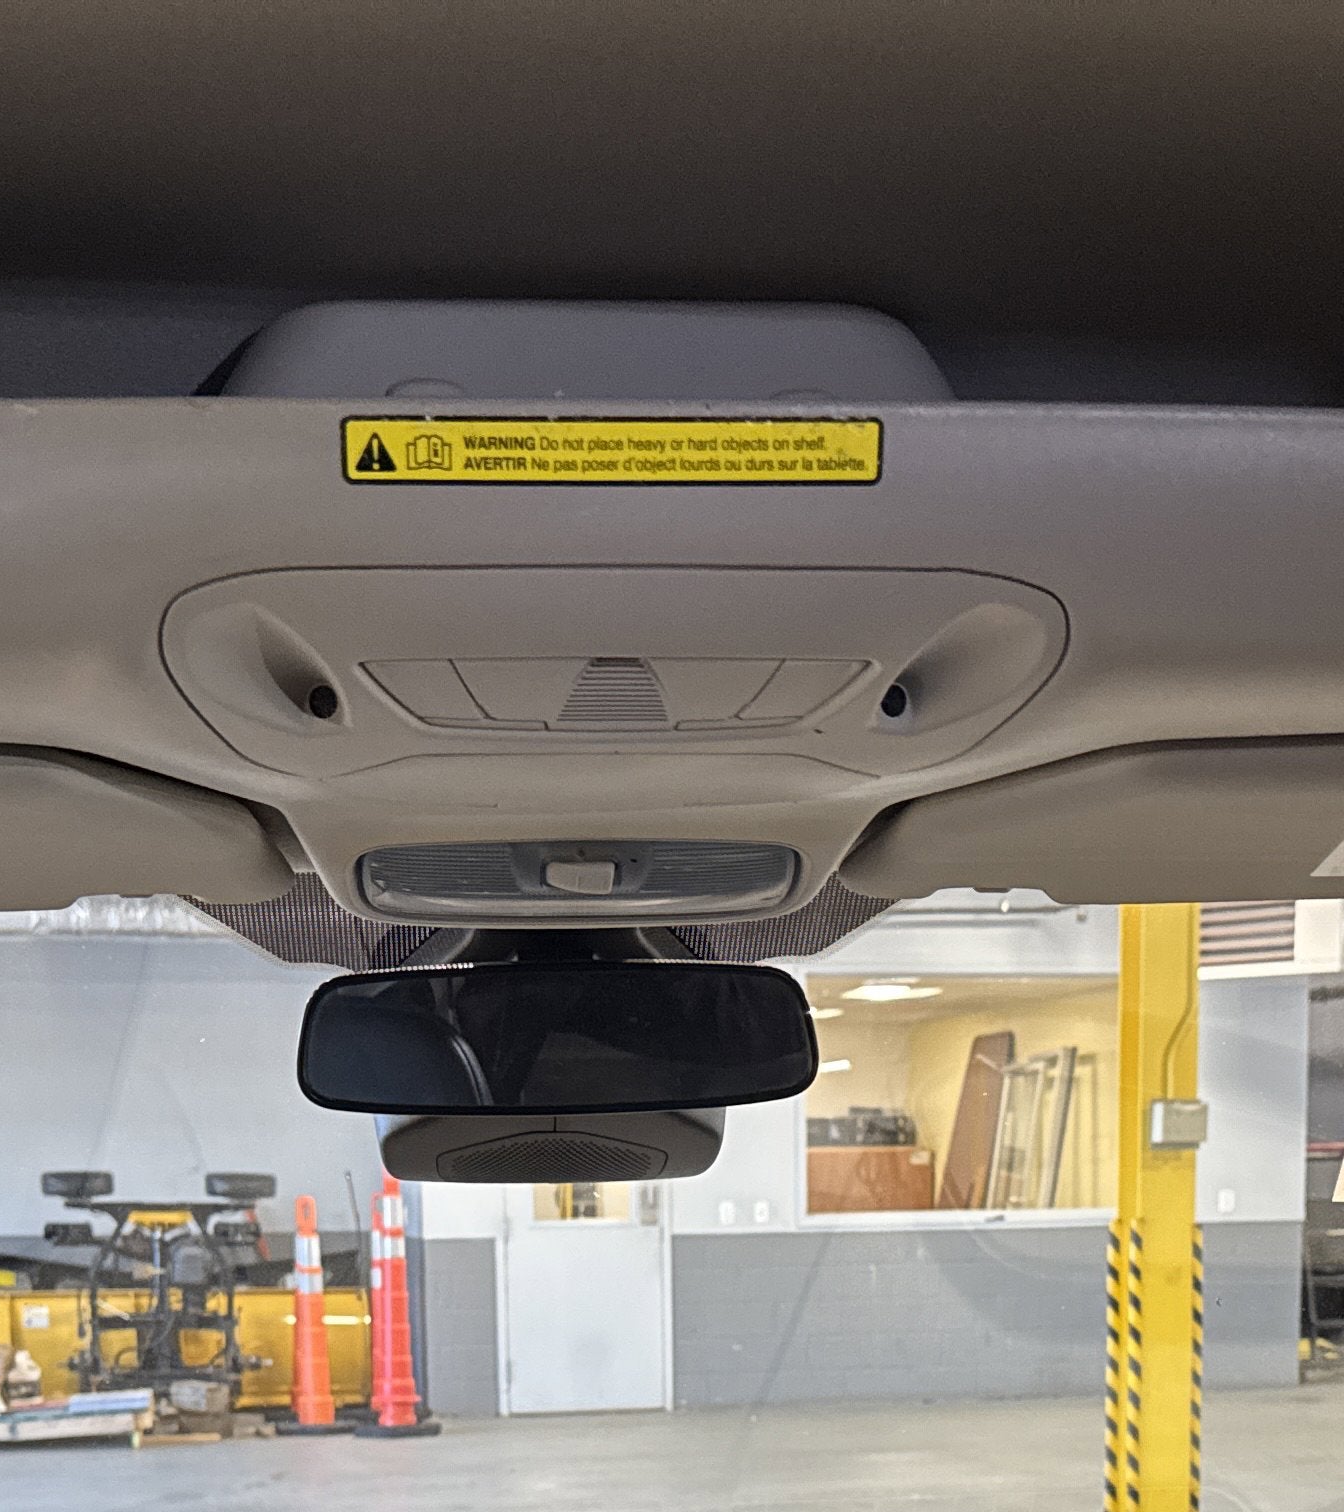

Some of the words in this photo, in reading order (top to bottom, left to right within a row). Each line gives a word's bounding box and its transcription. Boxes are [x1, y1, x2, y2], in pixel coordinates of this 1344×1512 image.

[463, 436, 536, 451] WARNING
[539, 437, 558, 451] Do
[562, 437, 585, 451] not
[588, 437, 624, 455] place
[628, 437, 666, 455] heavy
[670, 439, 684, 451] or
[687, 437, 718, 451] hard
[722, 437, 769, 455] objects
[772, 439, 790, 451] on
[463, 456, 527, 472] AVERTIR
[531, 457, 550, 471] Ne
[553, 459, 579, 474] pas
[581, 459, 619, 475] poser
[679, 457, 721, 472] lourds
[724, 459, 742, 472] ou
[745, 457, 775, 472] durs
[778, 459, 799, 472] sur
[802, 456, 813, 472] la
